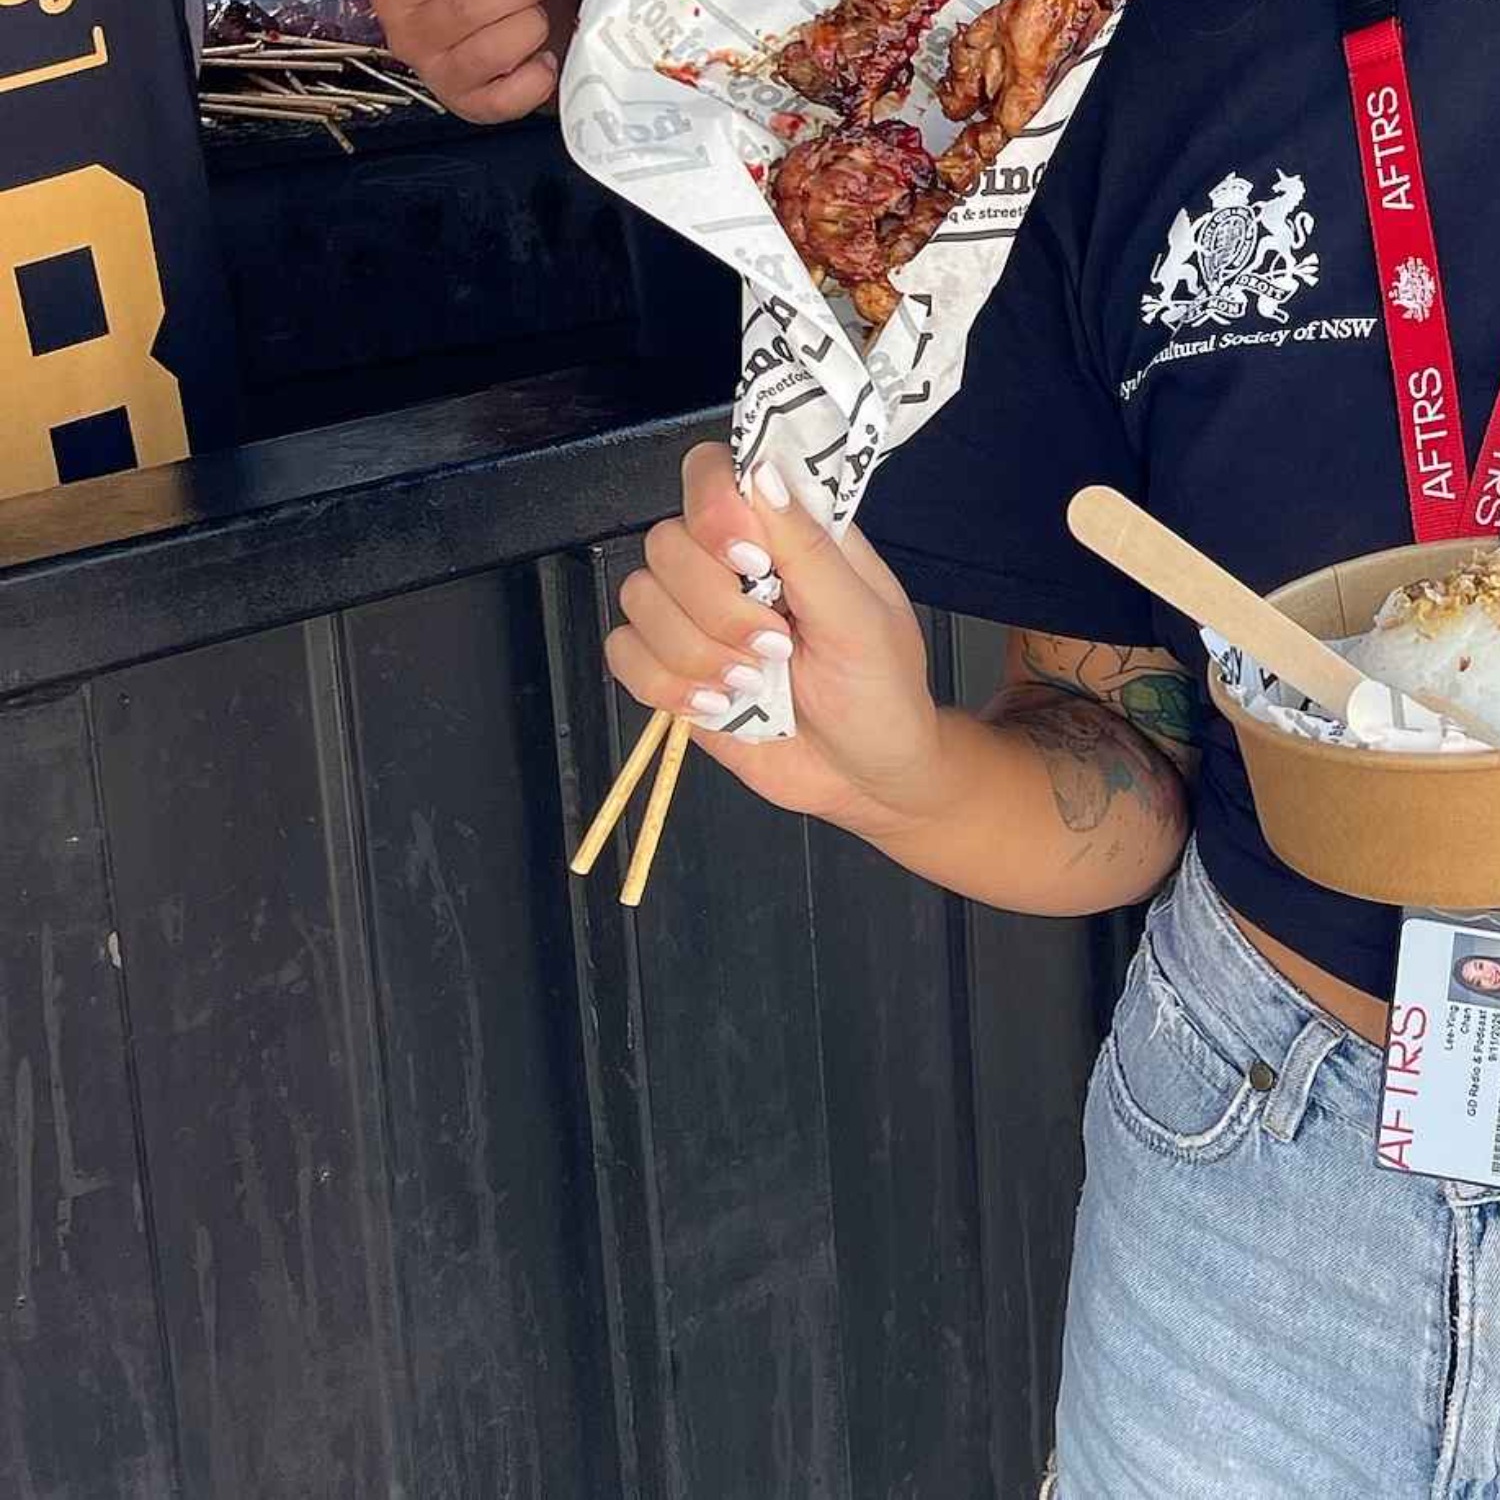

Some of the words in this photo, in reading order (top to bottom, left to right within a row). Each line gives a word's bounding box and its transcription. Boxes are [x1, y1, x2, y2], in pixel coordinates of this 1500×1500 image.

[1366, 85, 1414, 211] AFTRS
[1219, 329, 1291, 348] Society
[1293, 323, 1317, 342] of
[1320, 317, 1378, 340] NSW
[1407, 366, 1455, 501] AFTRS
[1474, 1009, 1489, 1056] Podcast
[1469, 1062, 1483, 1099] Radio
